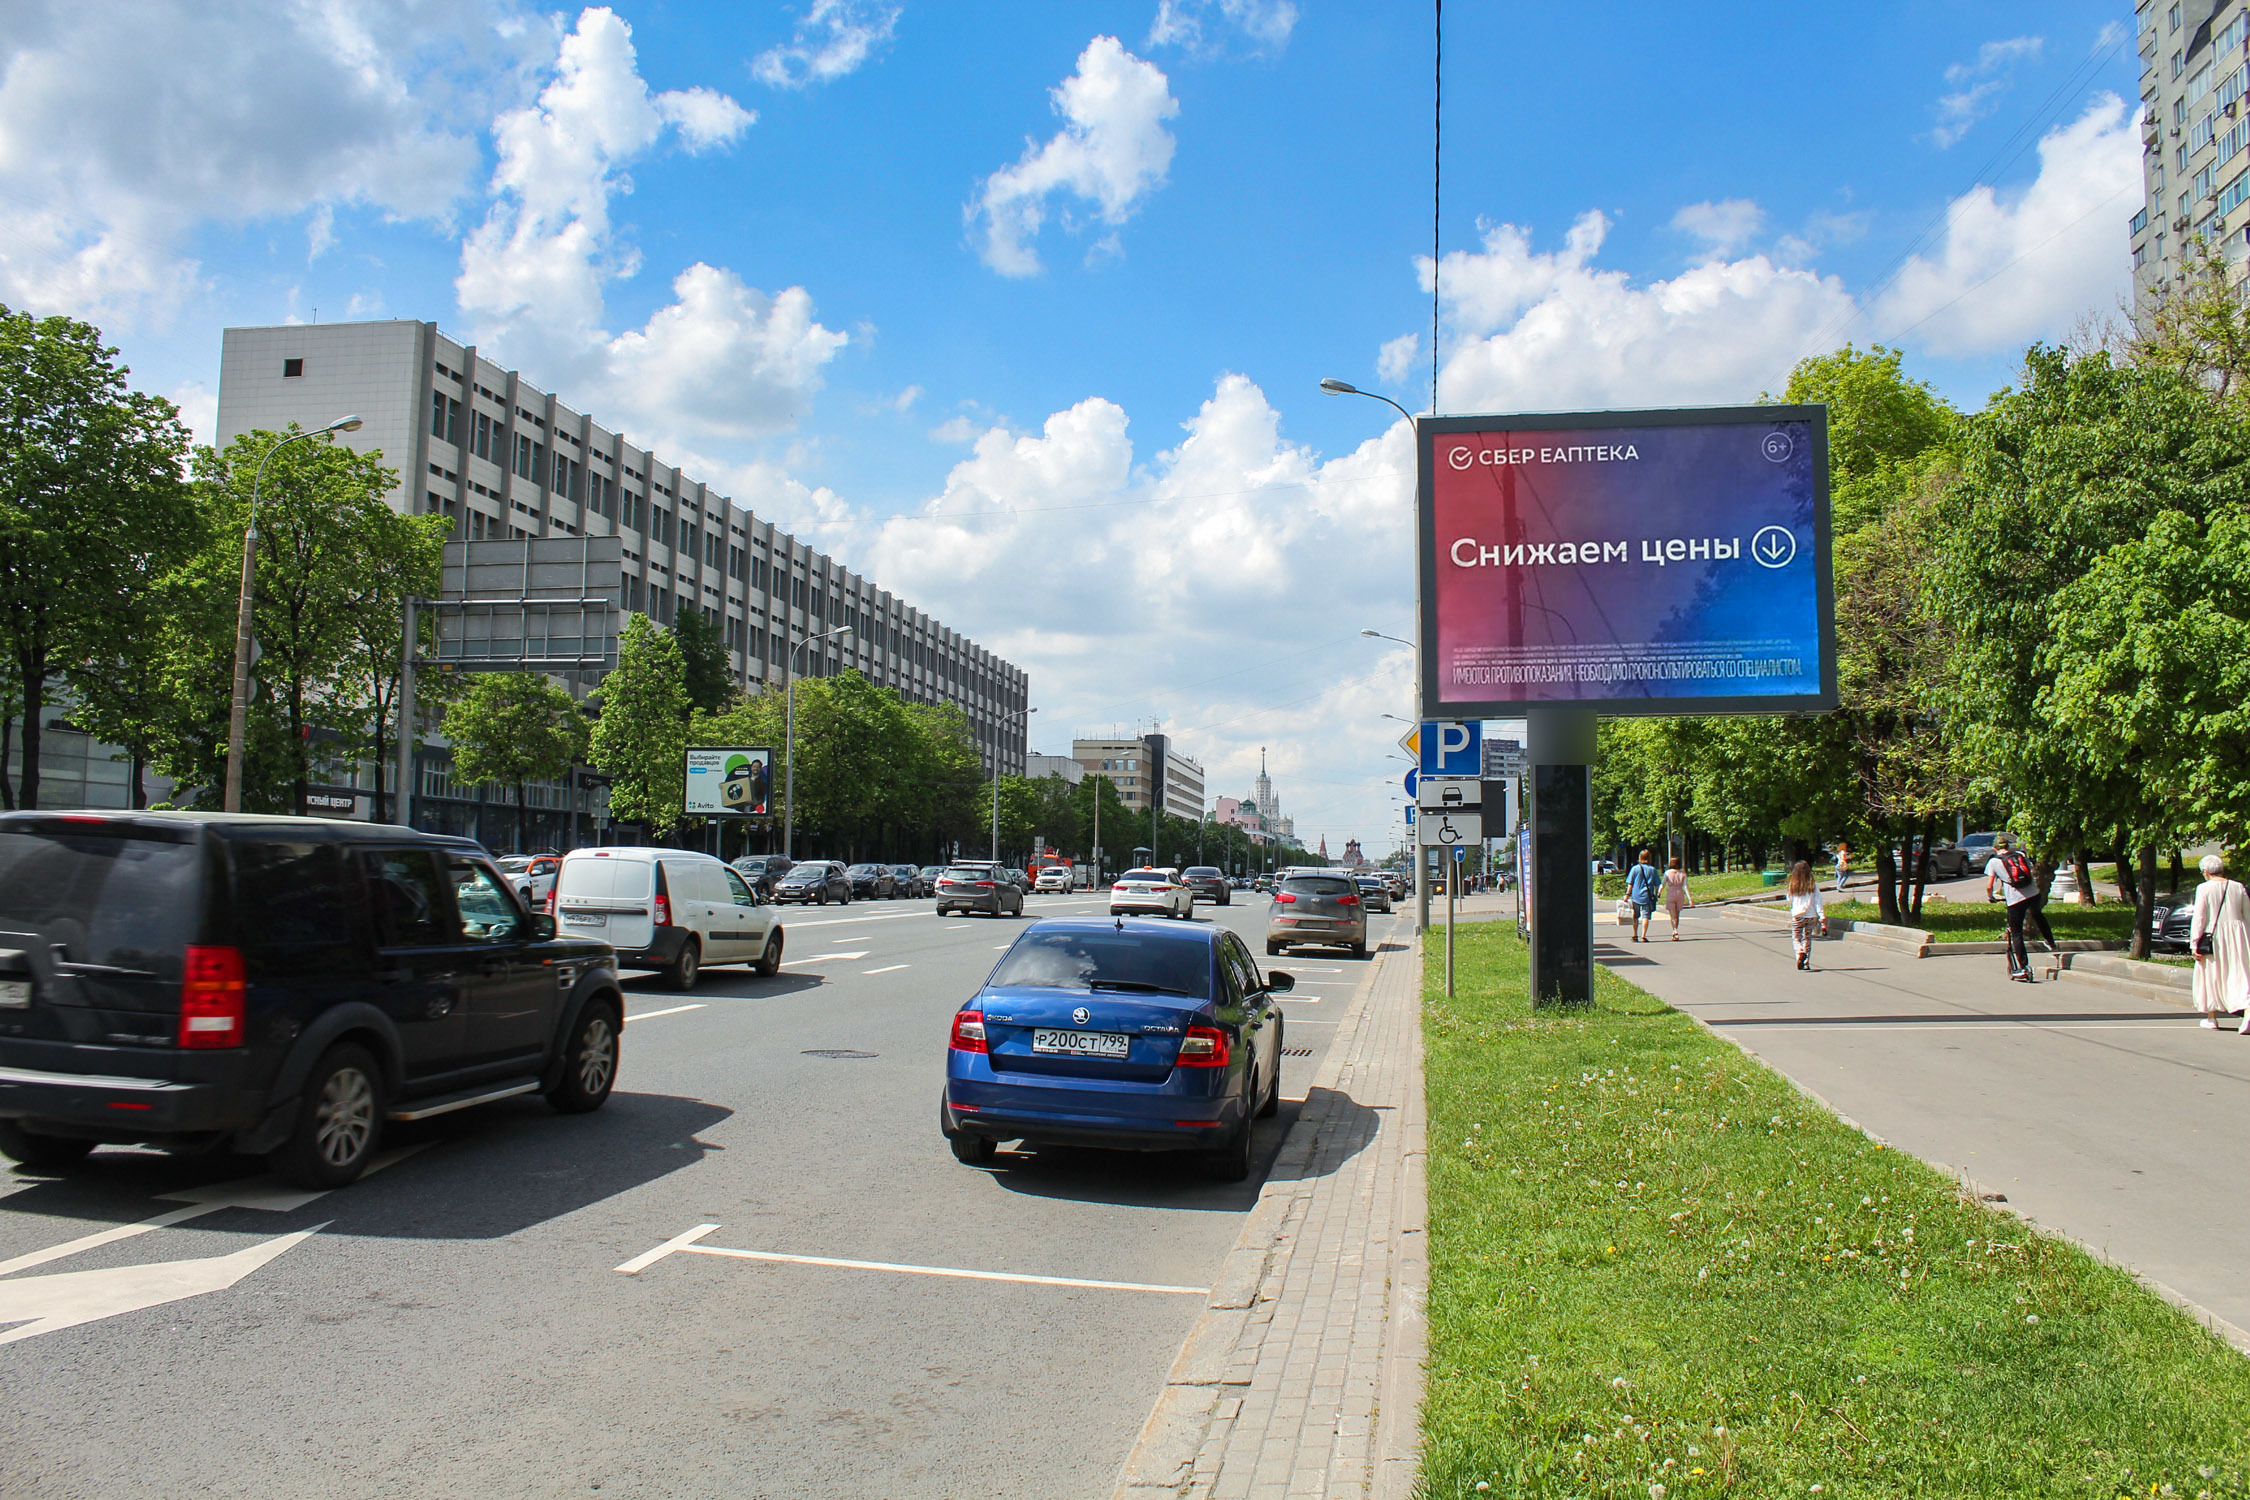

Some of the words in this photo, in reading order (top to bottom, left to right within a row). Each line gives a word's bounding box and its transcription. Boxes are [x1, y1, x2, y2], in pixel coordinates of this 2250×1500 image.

[1768, 440, 1787, 453] 6+
[1479, 449, 1535, 465] СБЕР
[1540, 445, 1639, 463] ЕАПТЕКА
[1451, 537, 1628, 568] Снижаем
[1642, 537, 1740, 566] цены
[330, 797, 352, 808] ЦЕНТР
[1144, 1025, 1180, 1033] OCTAVIA
